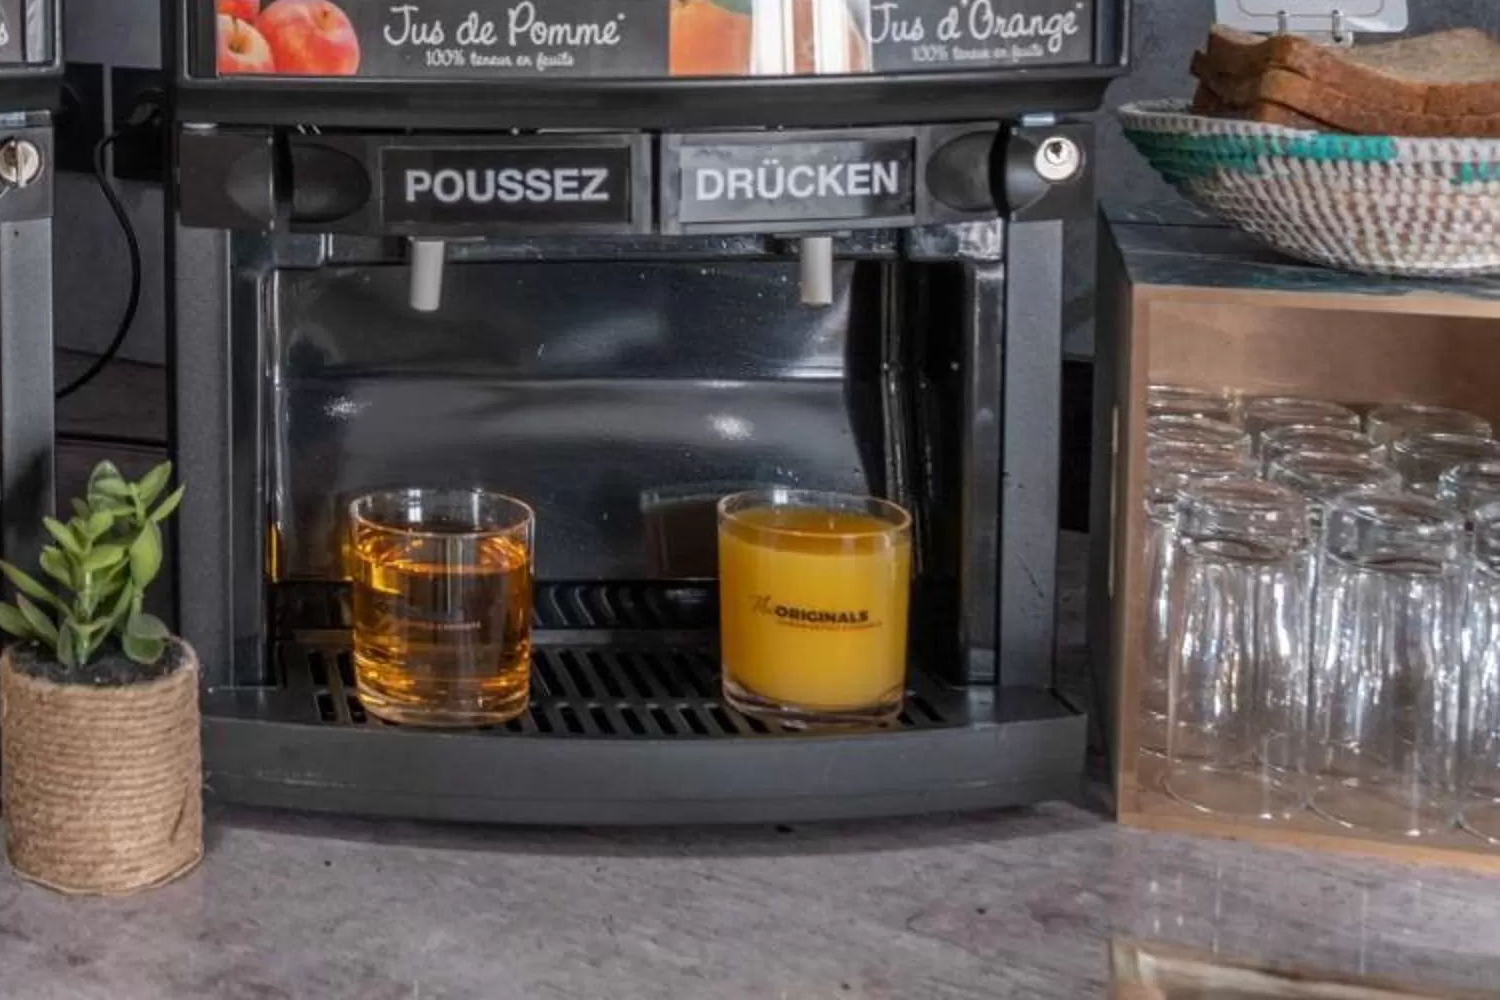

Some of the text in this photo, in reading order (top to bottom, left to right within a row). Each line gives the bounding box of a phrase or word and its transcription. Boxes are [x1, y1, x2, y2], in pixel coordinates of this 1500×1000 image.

[383, 3, 445, 46] Jus
[456, 11, 497, 46] de
[867, 1, 924, 43] Jus
[425, 48, 465, 68] 100%
[405, 167, 610, 203] POUSSEZ
[697, 157, 900, 202] DRÜCKEN
[774, 603, 870, 625] ORIGINALS
